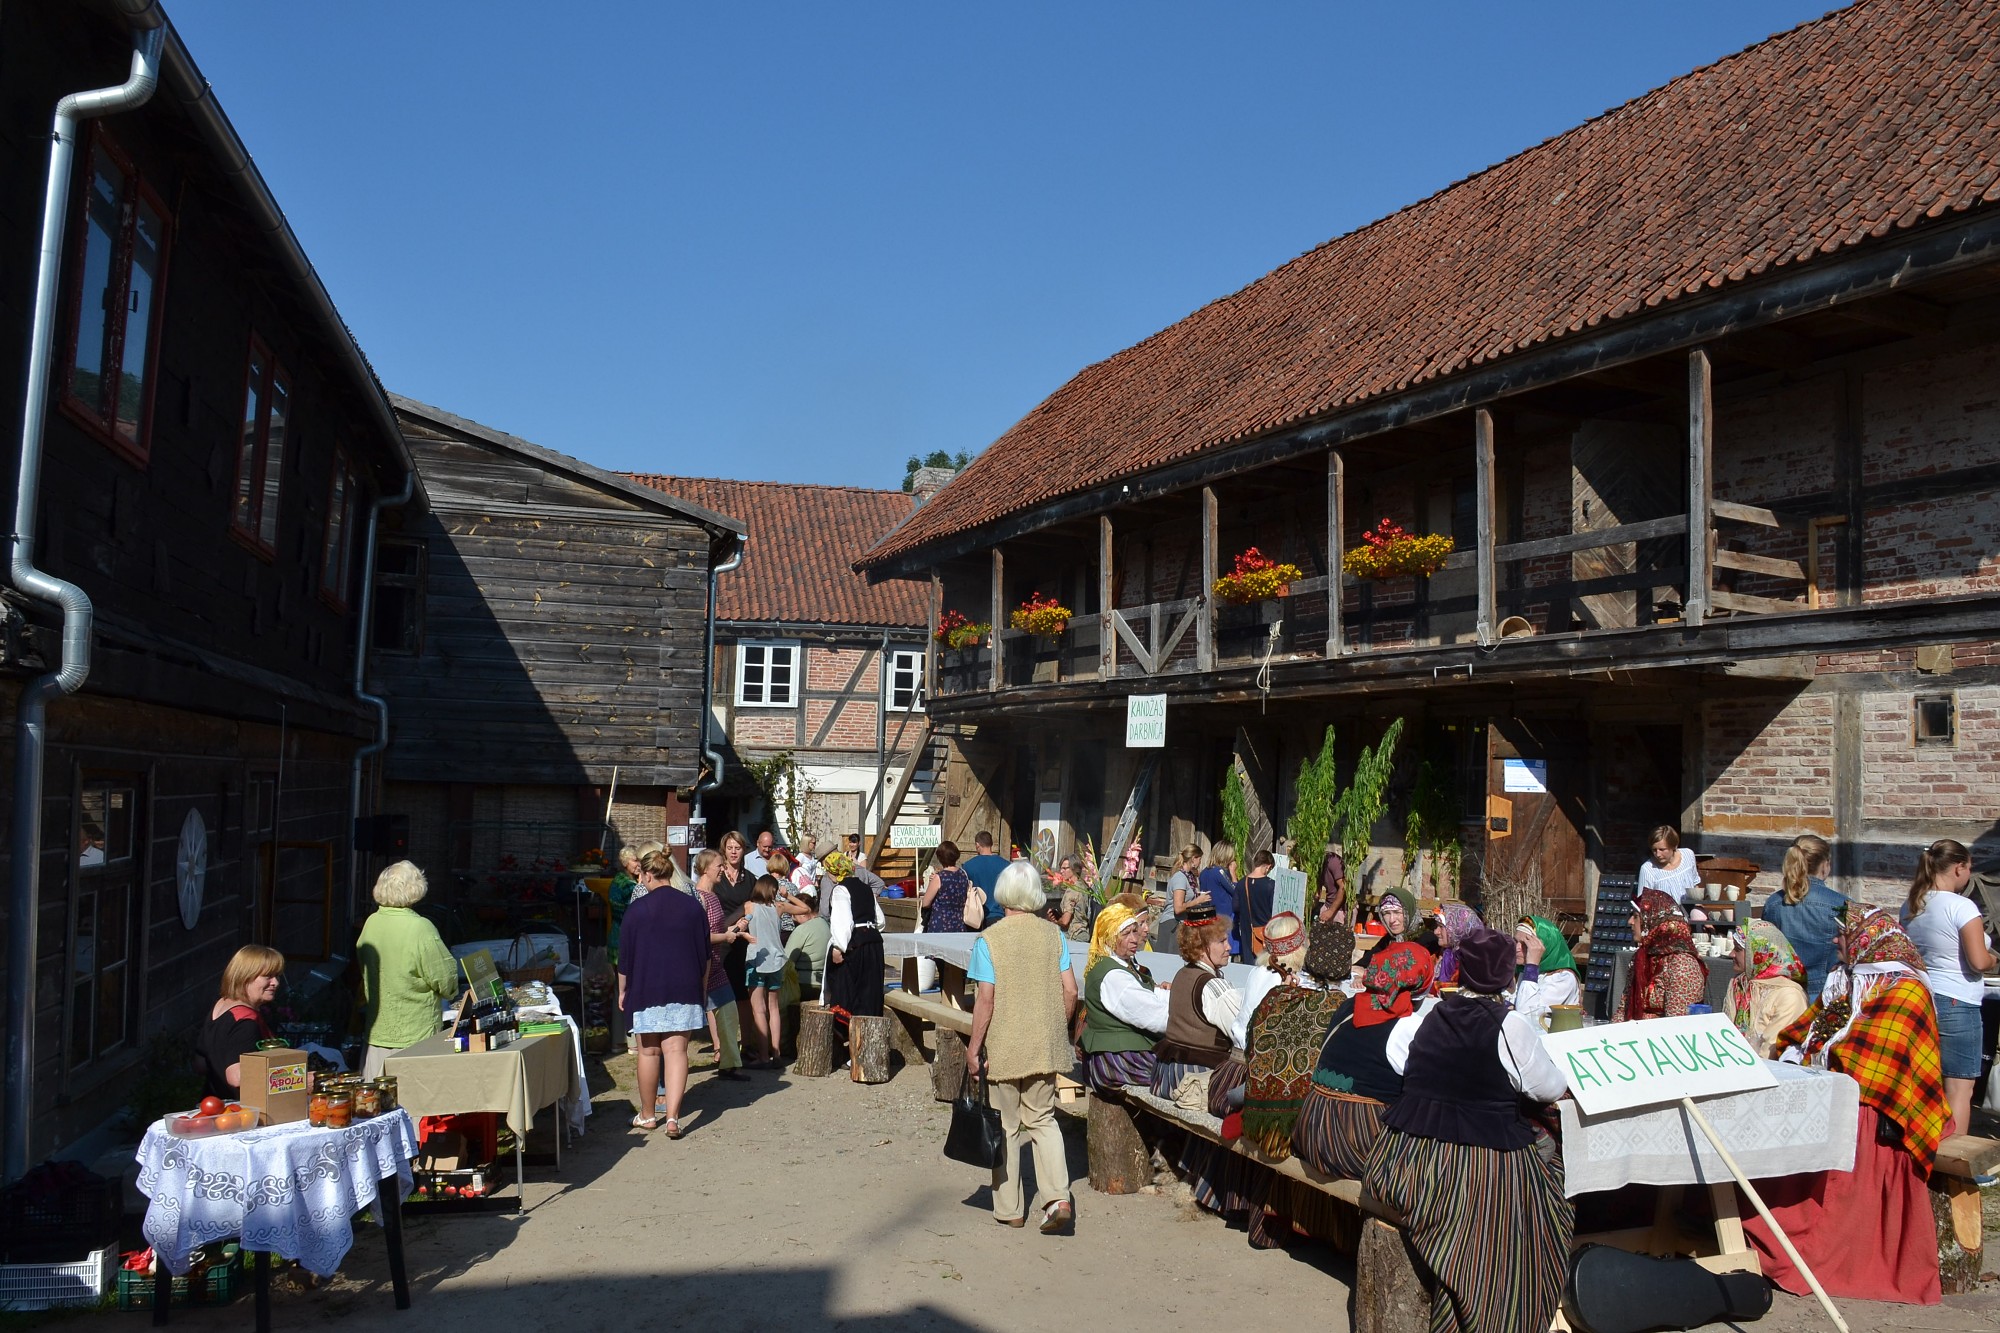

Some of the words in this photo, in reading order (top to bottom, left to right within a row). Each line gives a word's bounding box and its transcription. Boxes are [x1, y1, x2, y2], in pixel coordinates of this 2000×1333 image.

[1131, 697, 1164, 717] KANDŽAS
[1130, 720, 1163, 740] DARBNĪCA
[1566, 1028, 1756, 1091] ATŠTAUKAS
